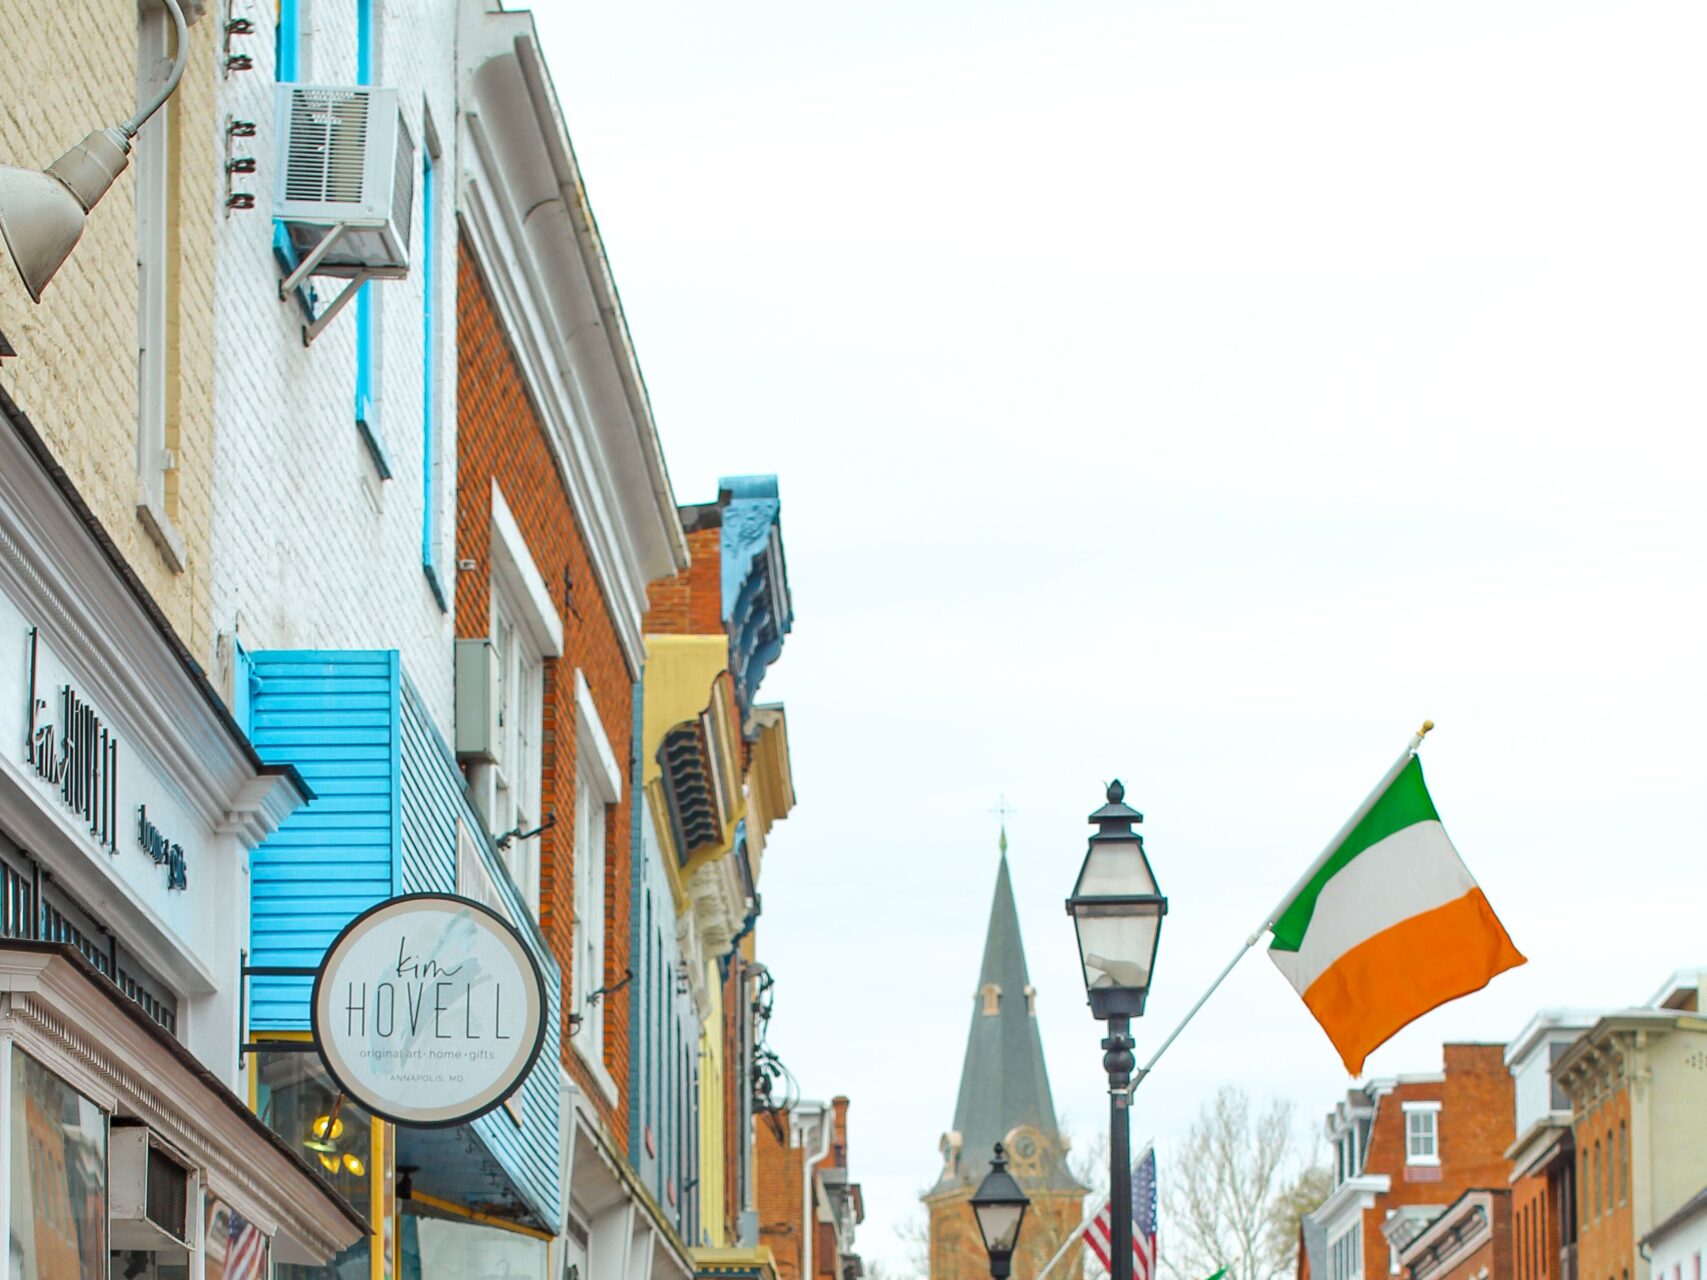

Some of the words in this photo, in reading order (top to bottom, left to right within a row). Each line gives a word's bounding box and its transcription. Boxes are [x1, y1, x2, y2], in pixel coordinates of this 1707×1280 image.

[396, 936, 462, 979] kim
[346, 982, 510, 1039] HOVELL
[359, 1049, 402, 1060] origina
[429, 1049, 461, 1059] home
[469, 1049, 495, 1061] gifts
[449, 1074, 463, 1082] MD
